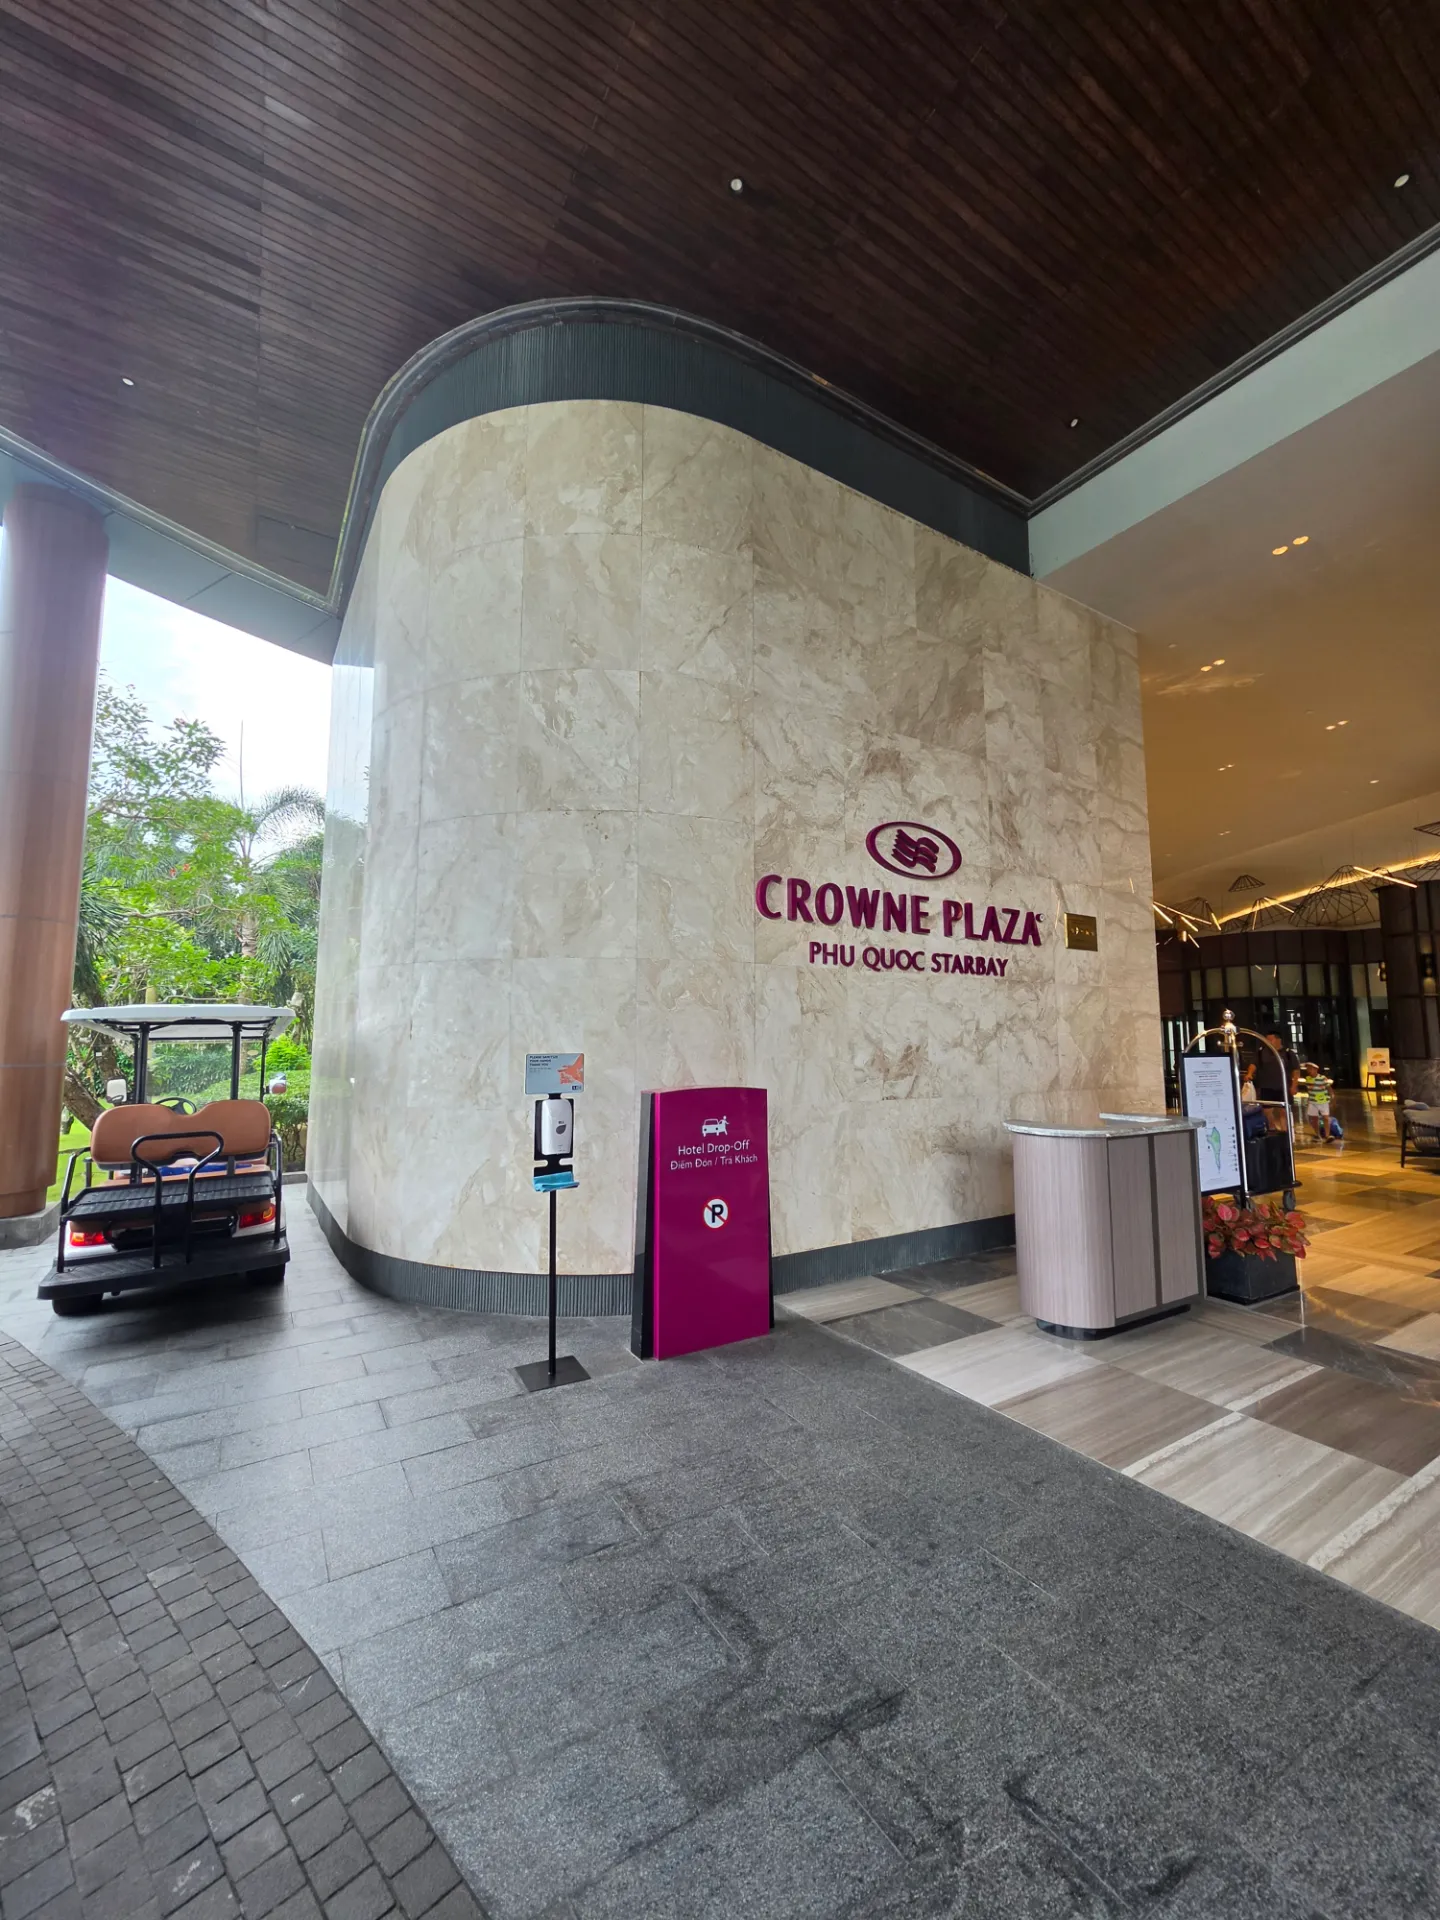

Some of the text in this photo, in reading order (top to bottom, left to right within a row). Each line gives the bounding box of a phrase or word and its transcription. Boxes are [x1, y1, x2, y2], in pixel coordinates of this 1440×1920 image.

[756, 874, 931, 935] CROWNE
[809, 941, 1008, 978] PHU QUOC STARBAY
[678, 1139, 750, 1156] Hotel Drop-Off
[711, 1204, 724, 1223] P
